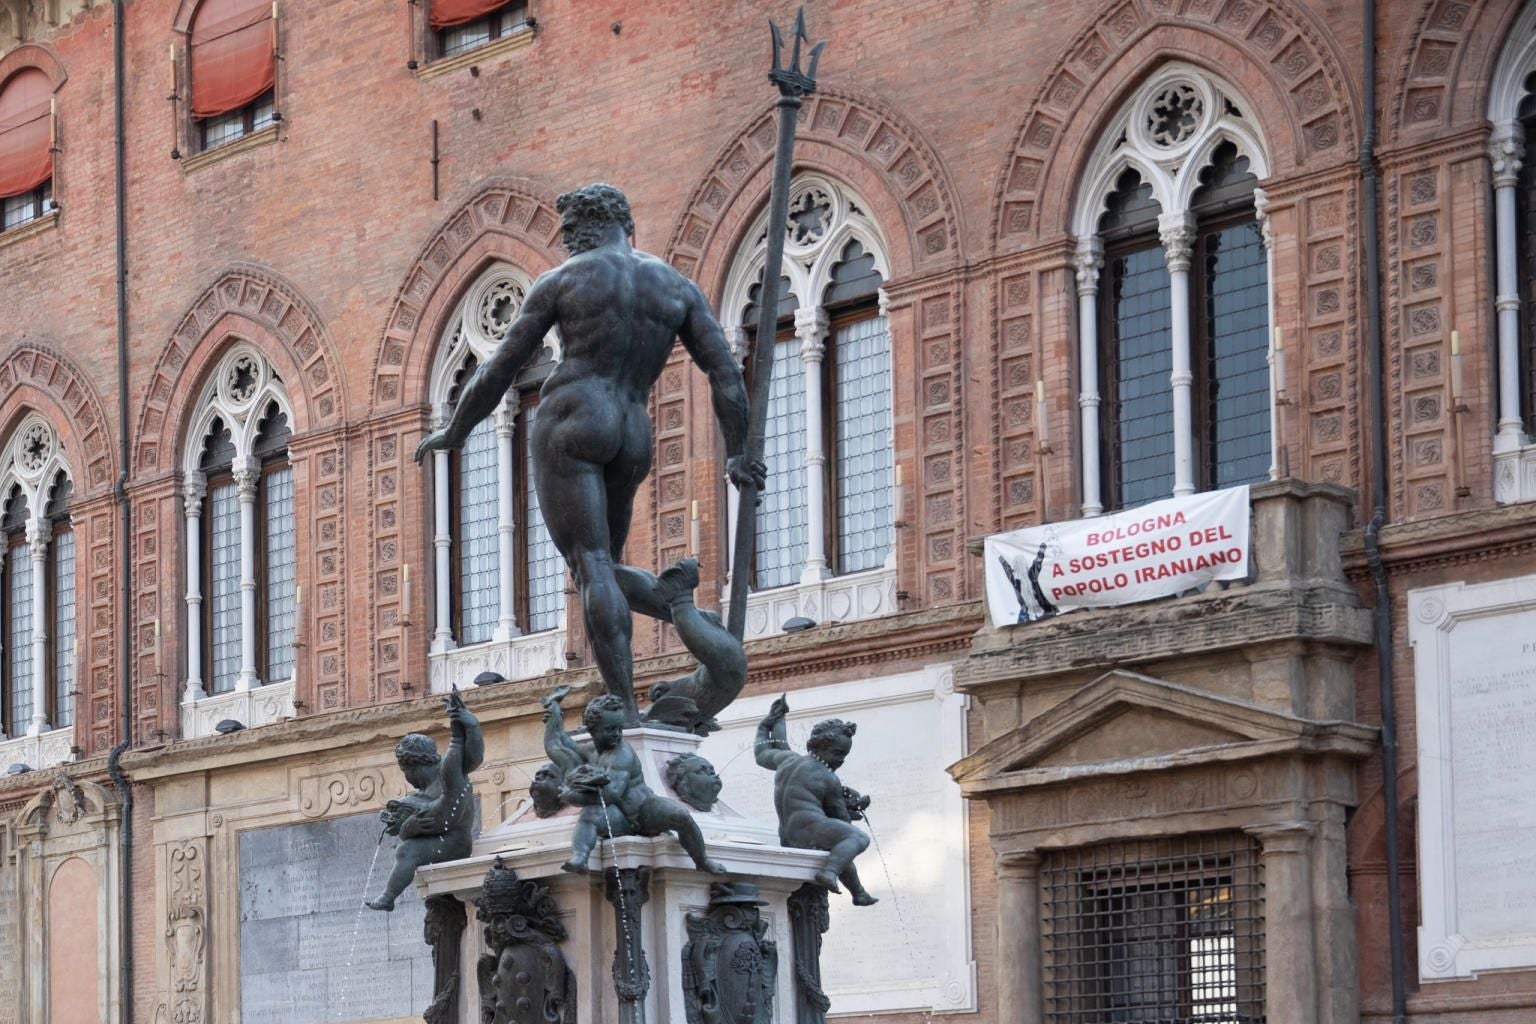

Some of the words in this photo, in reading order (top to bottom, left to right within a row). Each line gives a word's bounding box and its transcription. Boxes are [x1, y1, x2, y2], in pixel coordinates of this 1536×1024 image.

[1052, 562, 1064, 578] A
[1070, 535, 1182, 574] SOSTEGNO
[1189, 525, 1232, 547] DEL
[1086, 511, 1187, 547] BOLOGNA
[1052, 572, 1129, 601] POPOLO
[1134, 547, 1242, 585] IRANIANO
